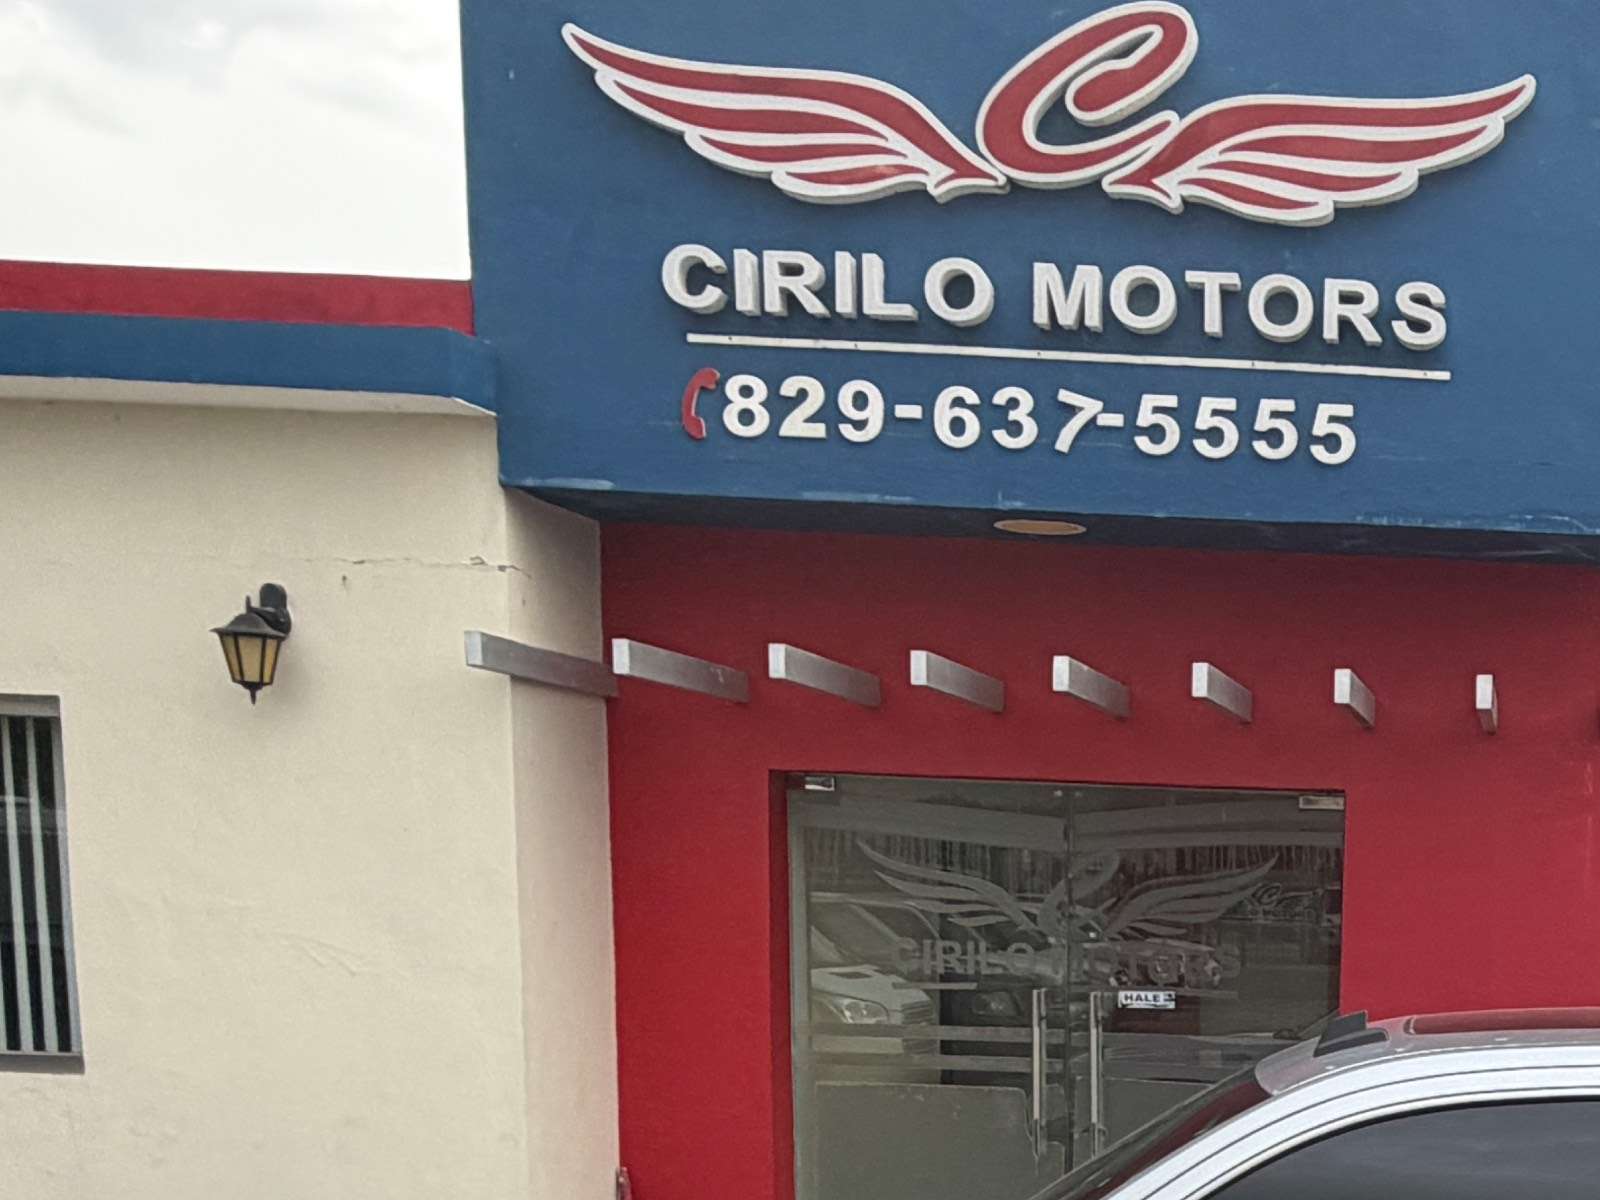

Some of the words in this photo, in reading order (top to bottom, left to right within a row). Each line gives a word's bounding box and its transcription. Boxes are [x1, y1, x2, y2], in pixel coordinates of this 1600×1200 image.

[662, 244, 995, 327] CIRILO
[1033, 262, 1448, 350] MOTORS
[722, 374, 1357, 465] 829-637-5555
[892, 936, 1035, 976] CIRILO
[1123, 992, 1161, 1003] HALE
